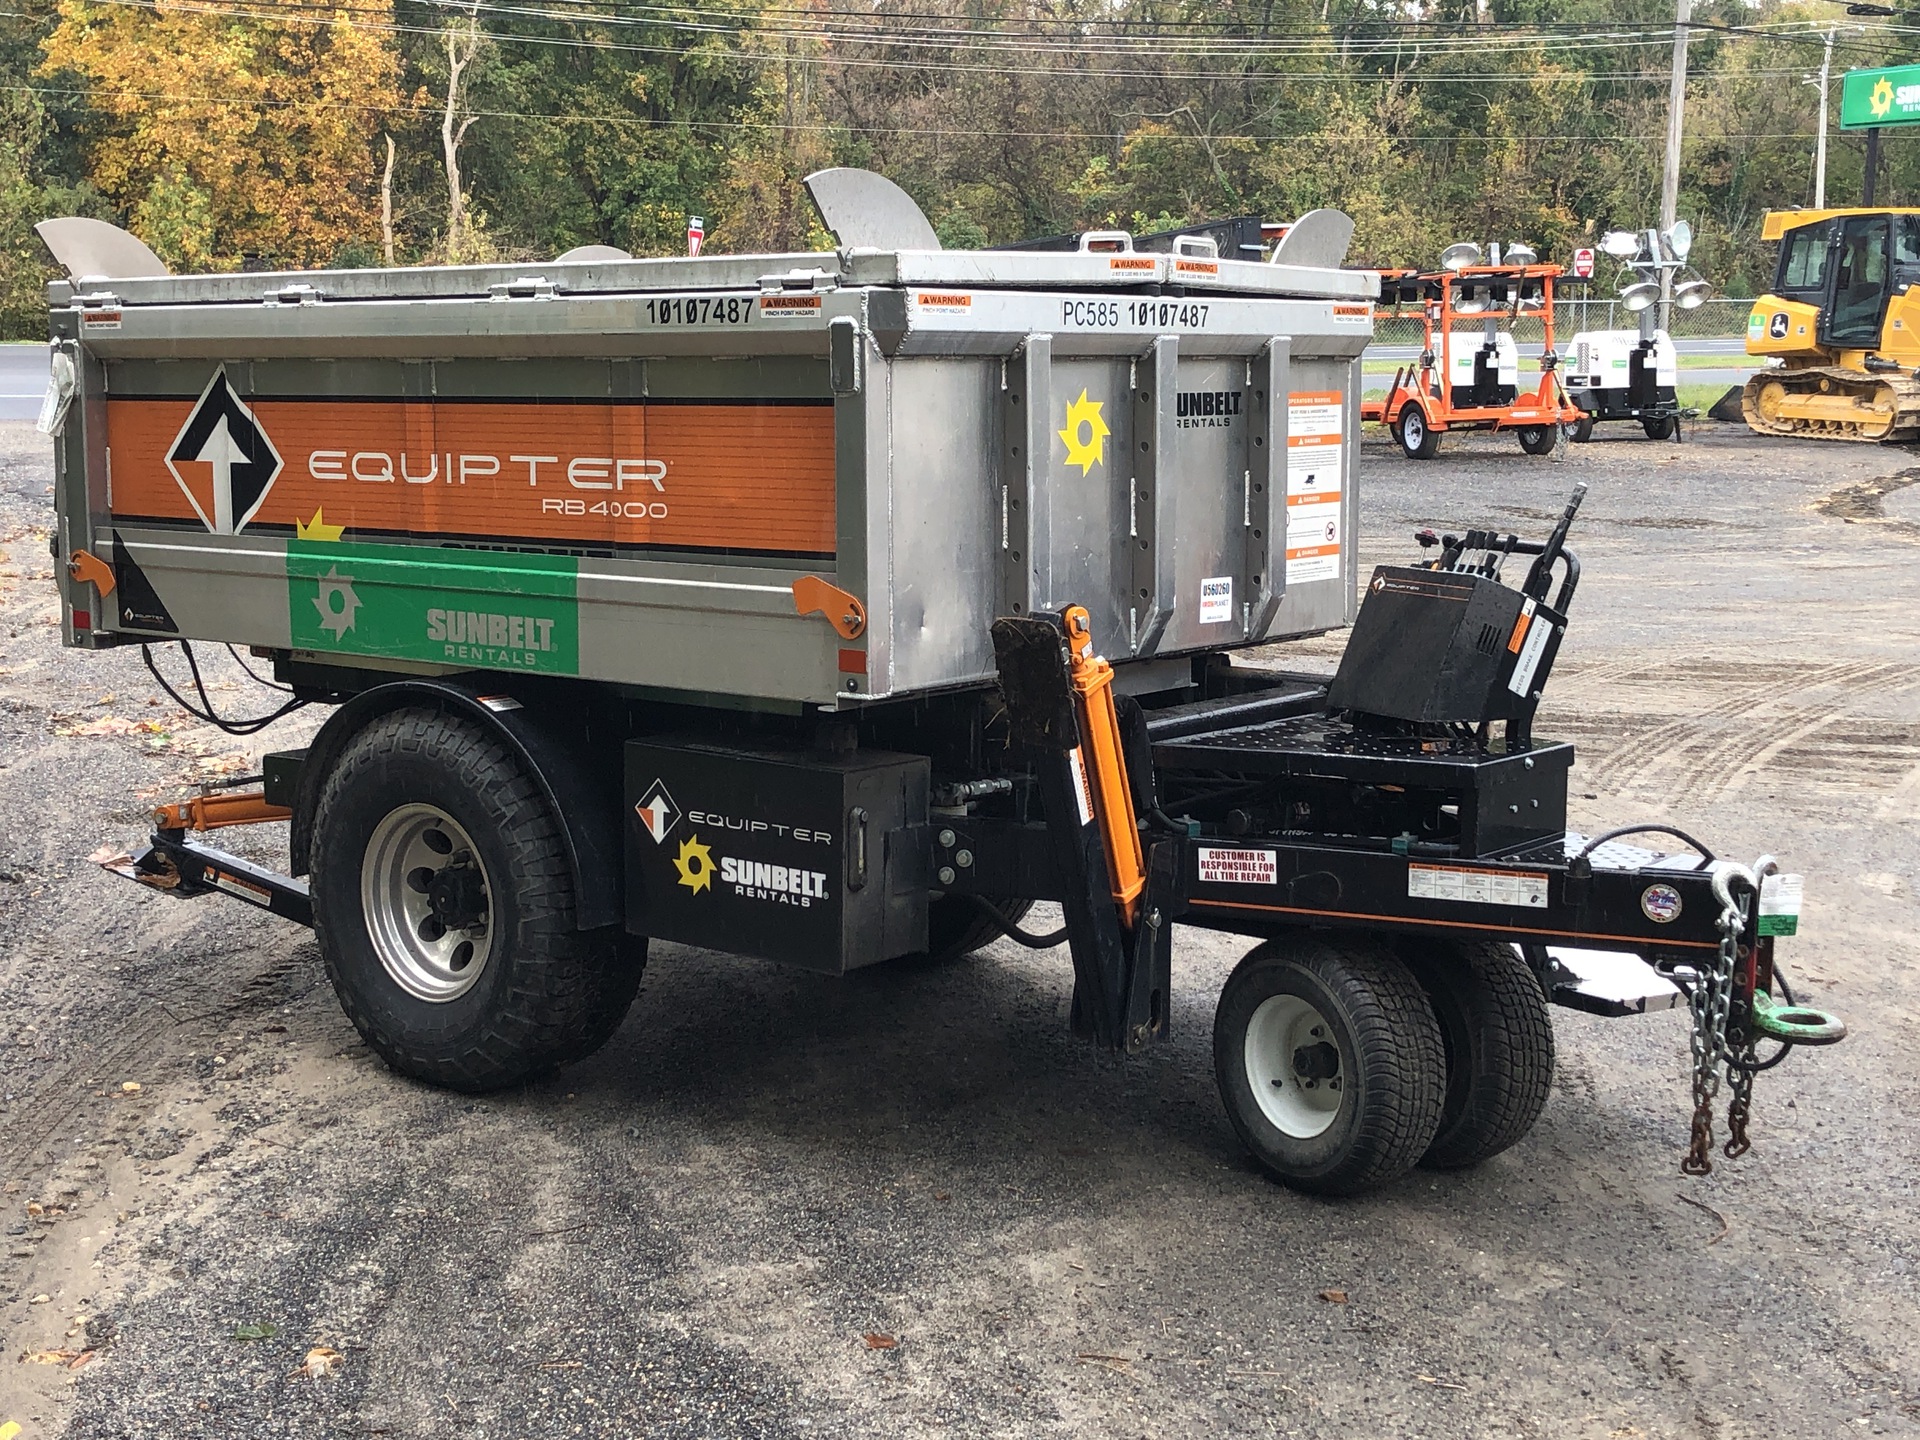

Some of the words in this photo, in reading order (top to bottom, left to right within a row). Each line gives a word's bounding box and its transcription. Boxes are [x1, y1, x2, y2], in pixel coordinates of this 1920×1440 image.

[1120, 261, 1150, 269] WARNING
[1184, 263, 1213, 273] WARNING
[646, 298, 754, 324] 10107487
[773, 298, 815, 307] WARNING
[930, 296, 966, 305] WARNING
[1063, 301, 1119, 327] PC585
[1128, 302, 1210, 328] 10107487
[1176, 391, 1242, 417] UNBELT
[308, 450, 667, 492] EQUIPTER
[542, 498, 668, 518] RB4000
[426, 608, 555, 652] SUNBELT
[444, 644, 536, 665] RENTALS
[688, 810, 832, 846] EQUIPTER
[1200, 860, 1257, 872] RESPONSIBLE
[1259, 863, 1275, 873] FOR
[1209, 850, 1255, 862] CUSTOMER
[1257, 852, 1266, 862] IS
[721, 856, 827, 899] SUNBELT
[1204, 871, 1218, 880] ALL
[1220, 872, 1239, 881] TIRE
[1240, 872, 1271, 882] REPAIR
[735, 885, 811, 908] RENTALS
